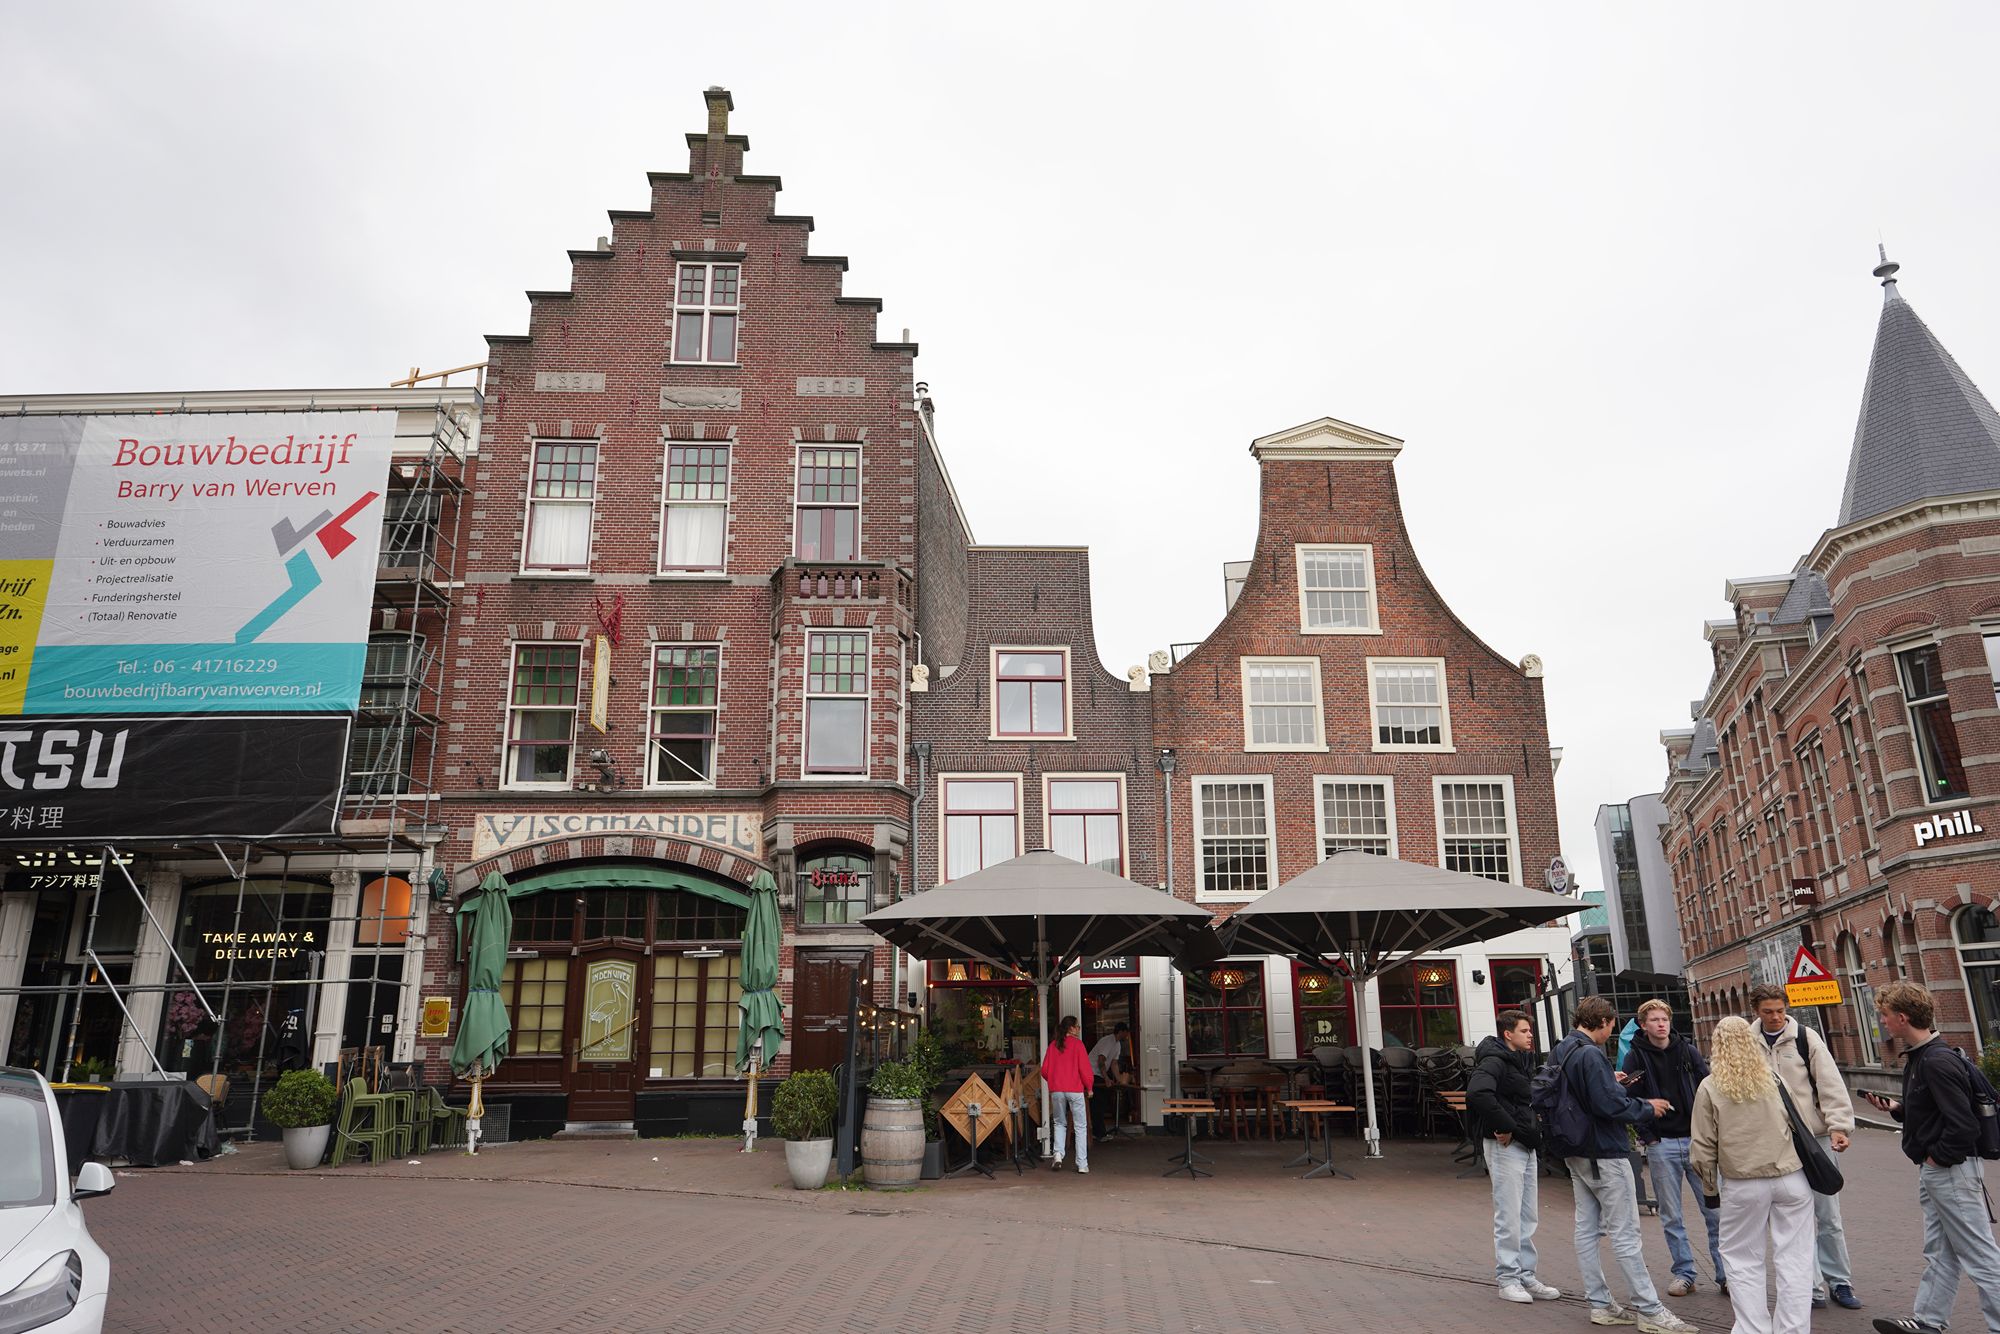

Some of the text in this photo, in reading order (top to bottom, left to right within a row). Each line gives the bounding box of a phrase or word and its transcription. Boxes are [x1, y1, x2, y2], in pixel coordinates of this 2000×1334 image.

[112, 433, 357, 474] Bouwbedrijf
[117, 479, 336, 502] Barry van Werven
[107, 519, 166, 529] Bouwadvies
[103, 538, 175, 547] Verduurzamen
[100, 557, 117, 566] Uit-
[134, 556, 176, 567] opbouw
[95, 574, 174, 586] Projectrealisatie
[92, 592, 181, 604] Funderingsherstel
[88, 611, 178, 623] (Totaal) Renovatie
[116, 660, 147, 674] Tel.:
[153, 659, 175, 673] 06
[191, 658, 278, 673] 41716229
[63, 682, 322, 701] bouwbedrijfbarryvanwerven.nl
[483, 814, 754, 854] VISCHHANDEL
[1913, 809, 1983, 847] phil.
[1793, 887, 1815, 897] phil.
[202, 931, 314, 943] TAKE AWAY &
[215, 947, 299, 959] DELIVERY
